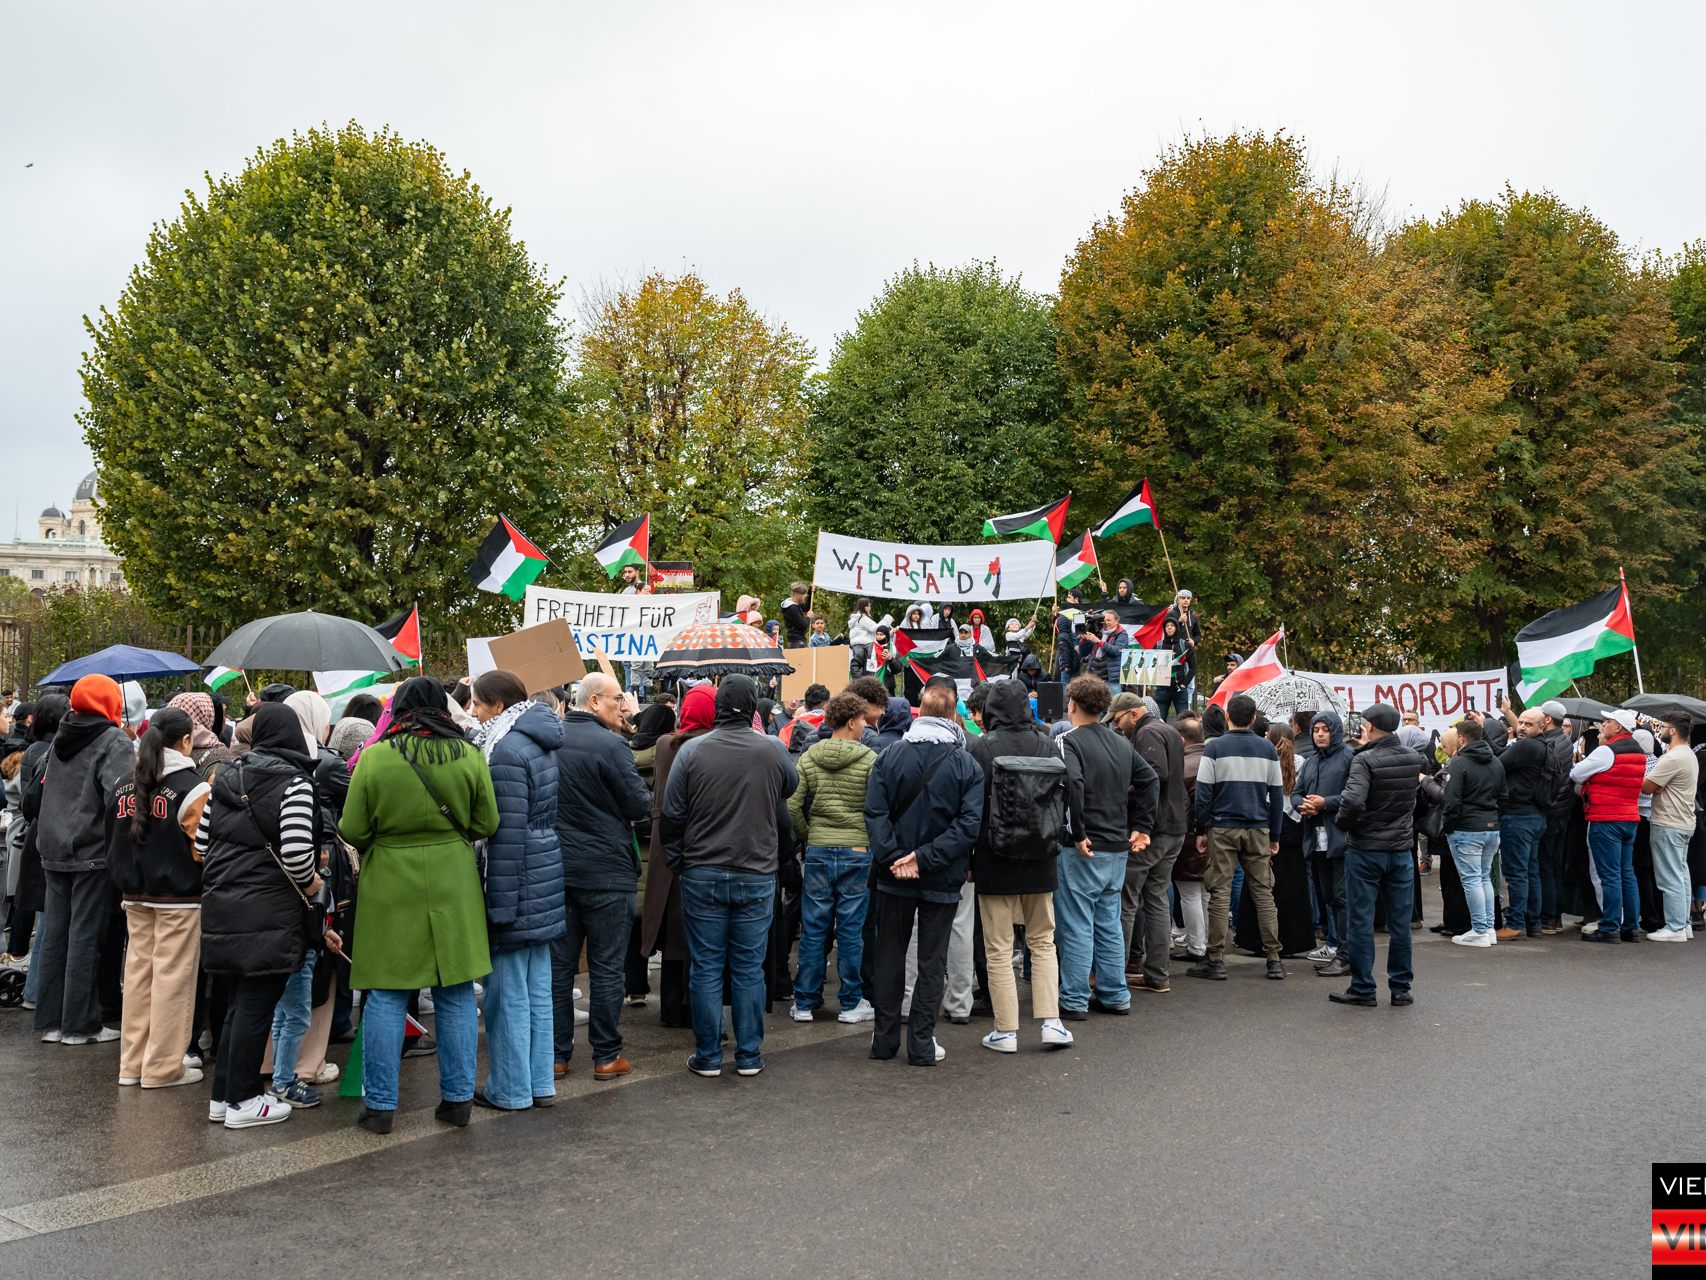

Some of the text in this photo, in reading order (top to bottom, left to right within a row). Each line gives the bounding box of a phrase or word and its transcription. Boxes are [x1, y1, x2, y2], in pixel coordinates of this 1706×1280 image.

[833, 548, 974, 594] WIDERSTAND
[537, 598, 676, 628] FREIHEIT FÜR
[574, 629, 658, 656] ÄSTINA
[1375, 677, 1500, 716] MORDET
[115, 783, 178, 801] OUTD PER
[117, 793, 168, 819] 190
